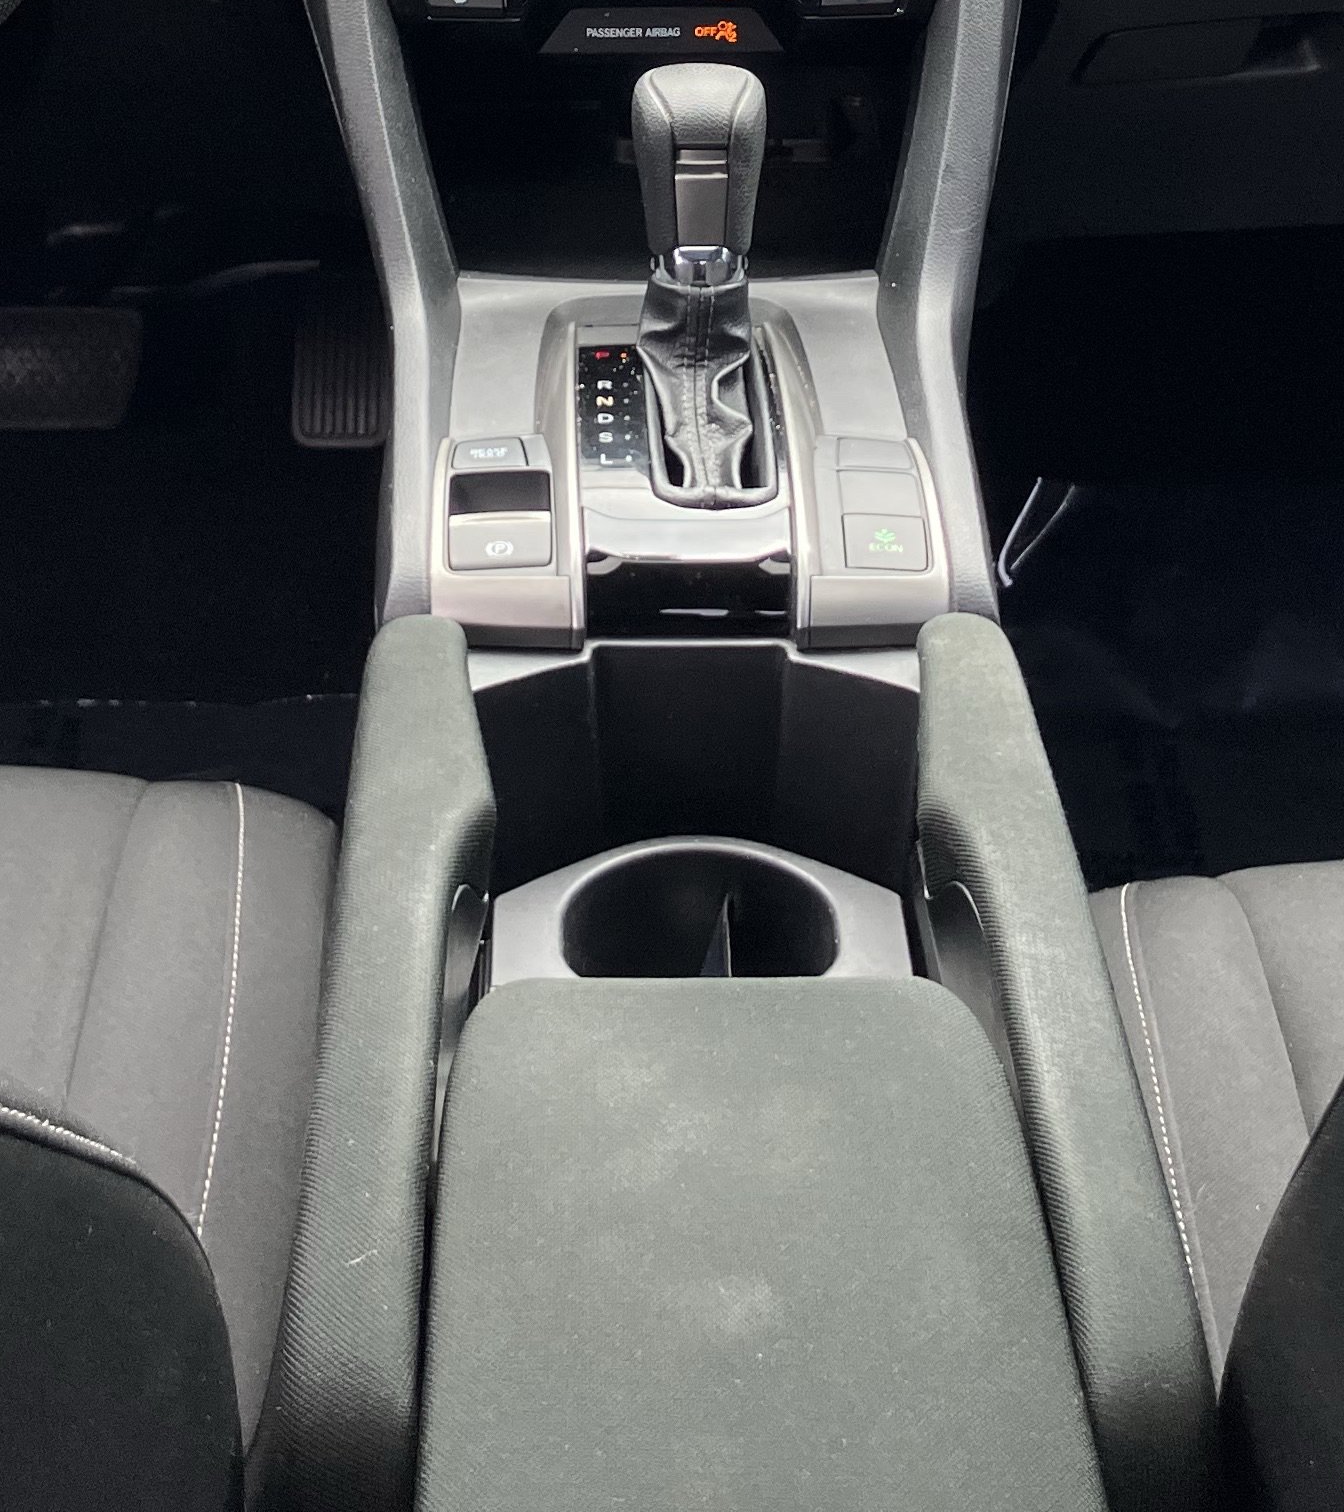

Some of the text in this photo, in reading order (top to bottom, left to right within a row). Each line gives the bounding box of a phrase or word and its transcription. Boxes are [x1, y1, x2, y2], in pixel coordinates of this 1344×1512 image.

[586, 27, 681, 38] PASSENGER AIRBAG
[694, 26, 717, 37] OFF
[596, 380, 613, 390] R
[595, 395, 614, 407] N
[597, 413, 614, 424] D
[598, 431, 614, 443] S
[600, 453, 613, 465] L
[868, 543, 903, 553] ECON
